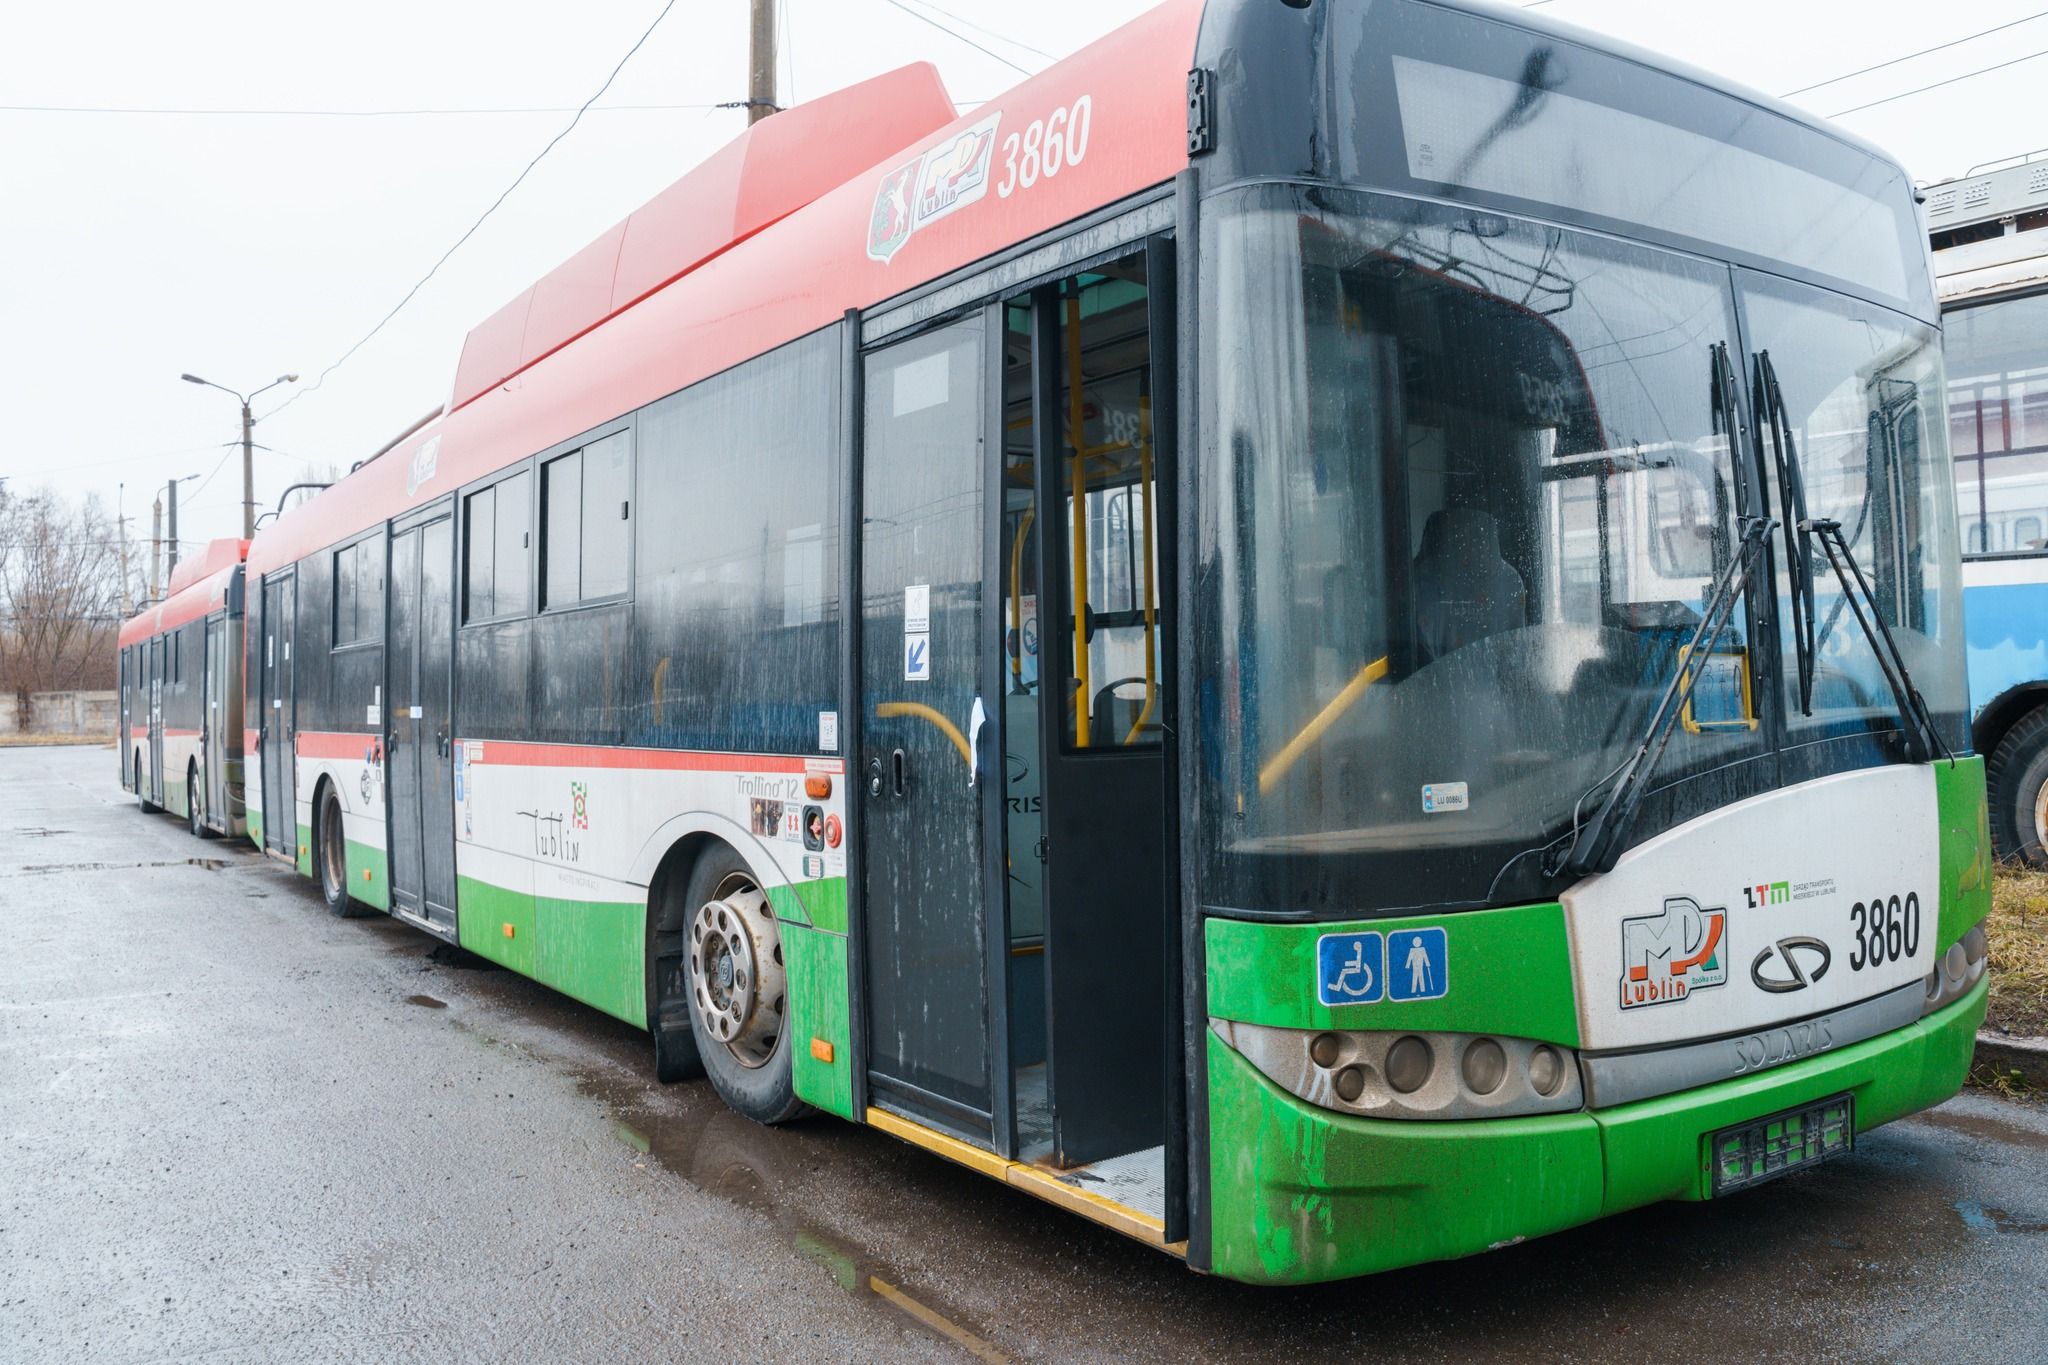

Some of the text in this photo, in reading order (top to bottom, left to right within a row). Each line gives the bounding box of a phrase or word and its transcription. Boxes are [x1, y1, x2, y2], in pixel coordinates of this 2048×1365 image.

[998, 95, 1091, 198] 3860
[921, 189, 956, 217] Lublin
[786, 779, 799, 800] 12
[1849, 891, 1920, 972] 3860
[1623, 977, 1686, 1005] Lublin
[1735, 1019, 1832, 1073] SOLARIS
